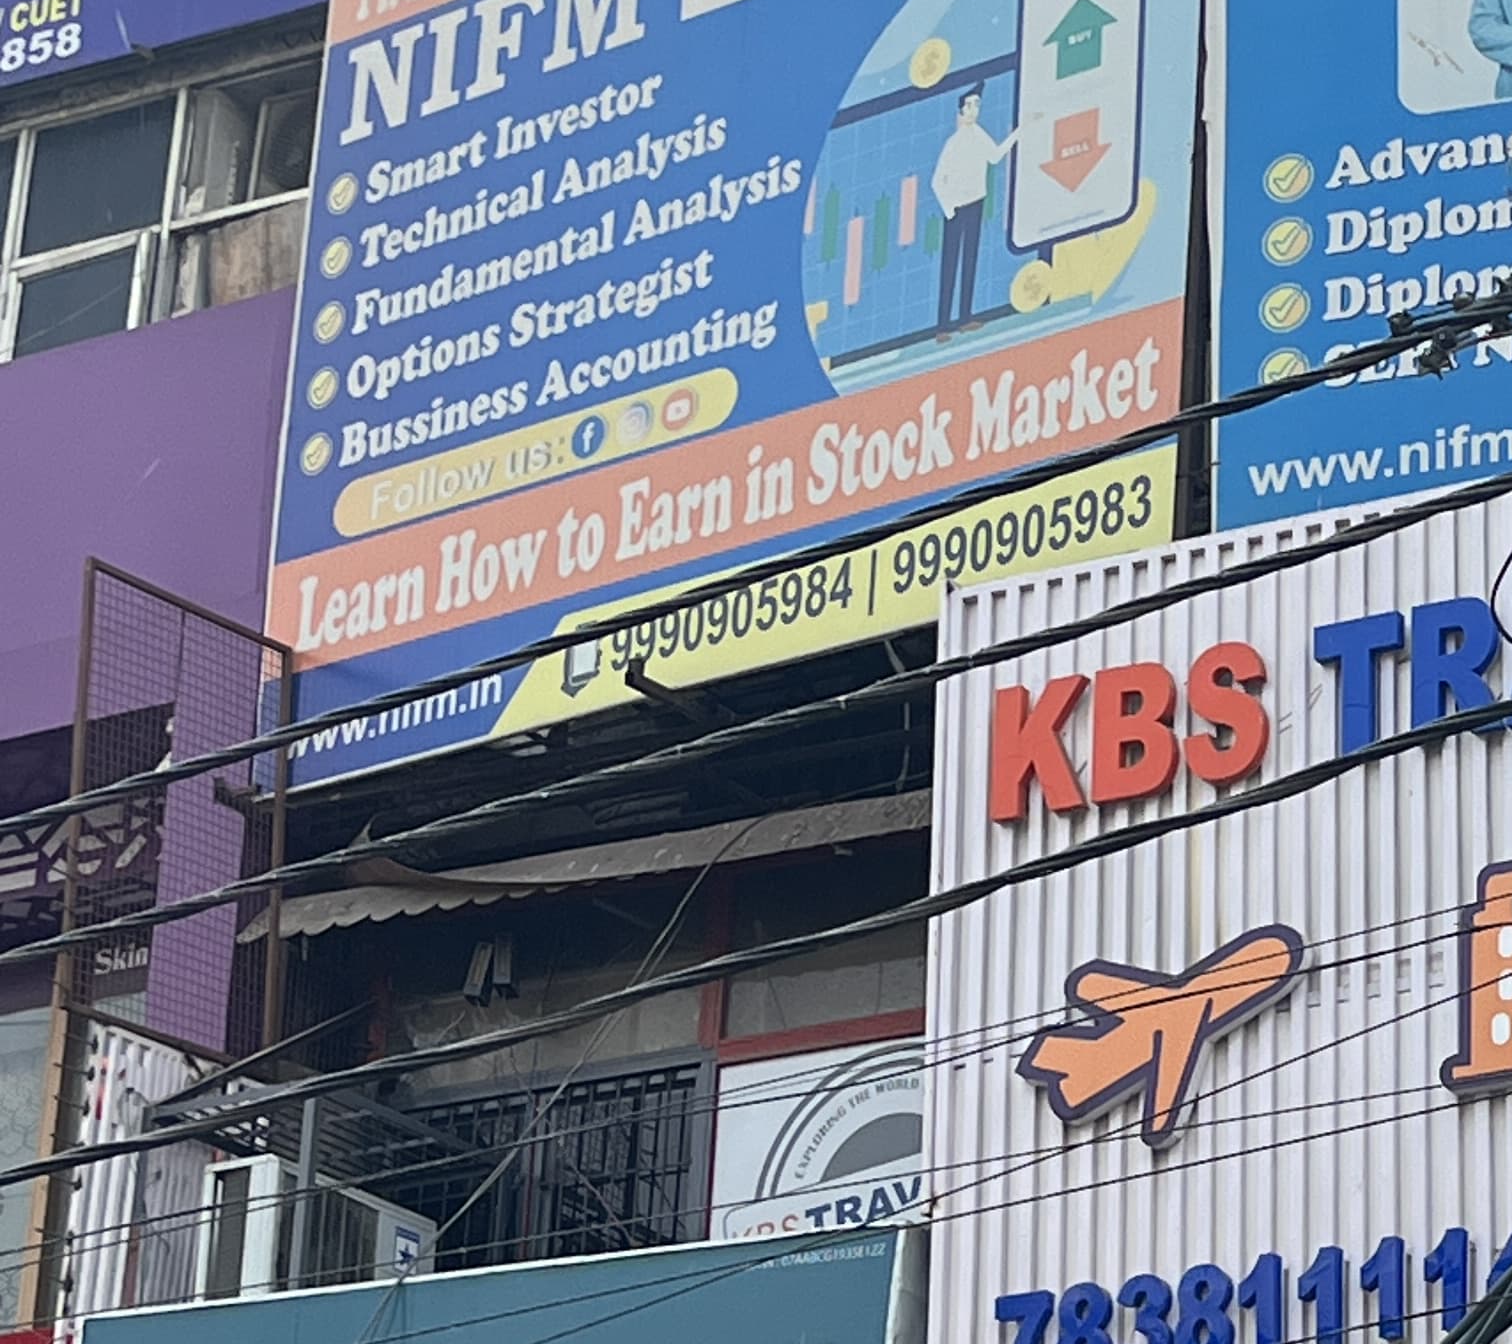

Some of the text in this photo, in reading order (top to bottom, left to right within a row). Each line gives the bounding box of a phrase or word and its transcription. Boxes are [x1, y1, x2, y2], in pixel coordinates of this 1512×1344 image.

[359, 114, 728, 268] Technical Analysis
[364, 72, 663, 204] Smart Investor
[352, 155, 803, 337] Fundamental Analysis
[338, 299, 779, 468] Bussiness Accounting
[346, 249, 713, 409] Options Strategist
[294, 336, 1162, 655] Learn How to Earn in Stock Market
[369, 438, 566, 522] Follow us:
[893, 474, 1153, 594] 9990905983
[989, 641, 1270, 824] KBS
[875, 1077, 920, 1095] WORLD
